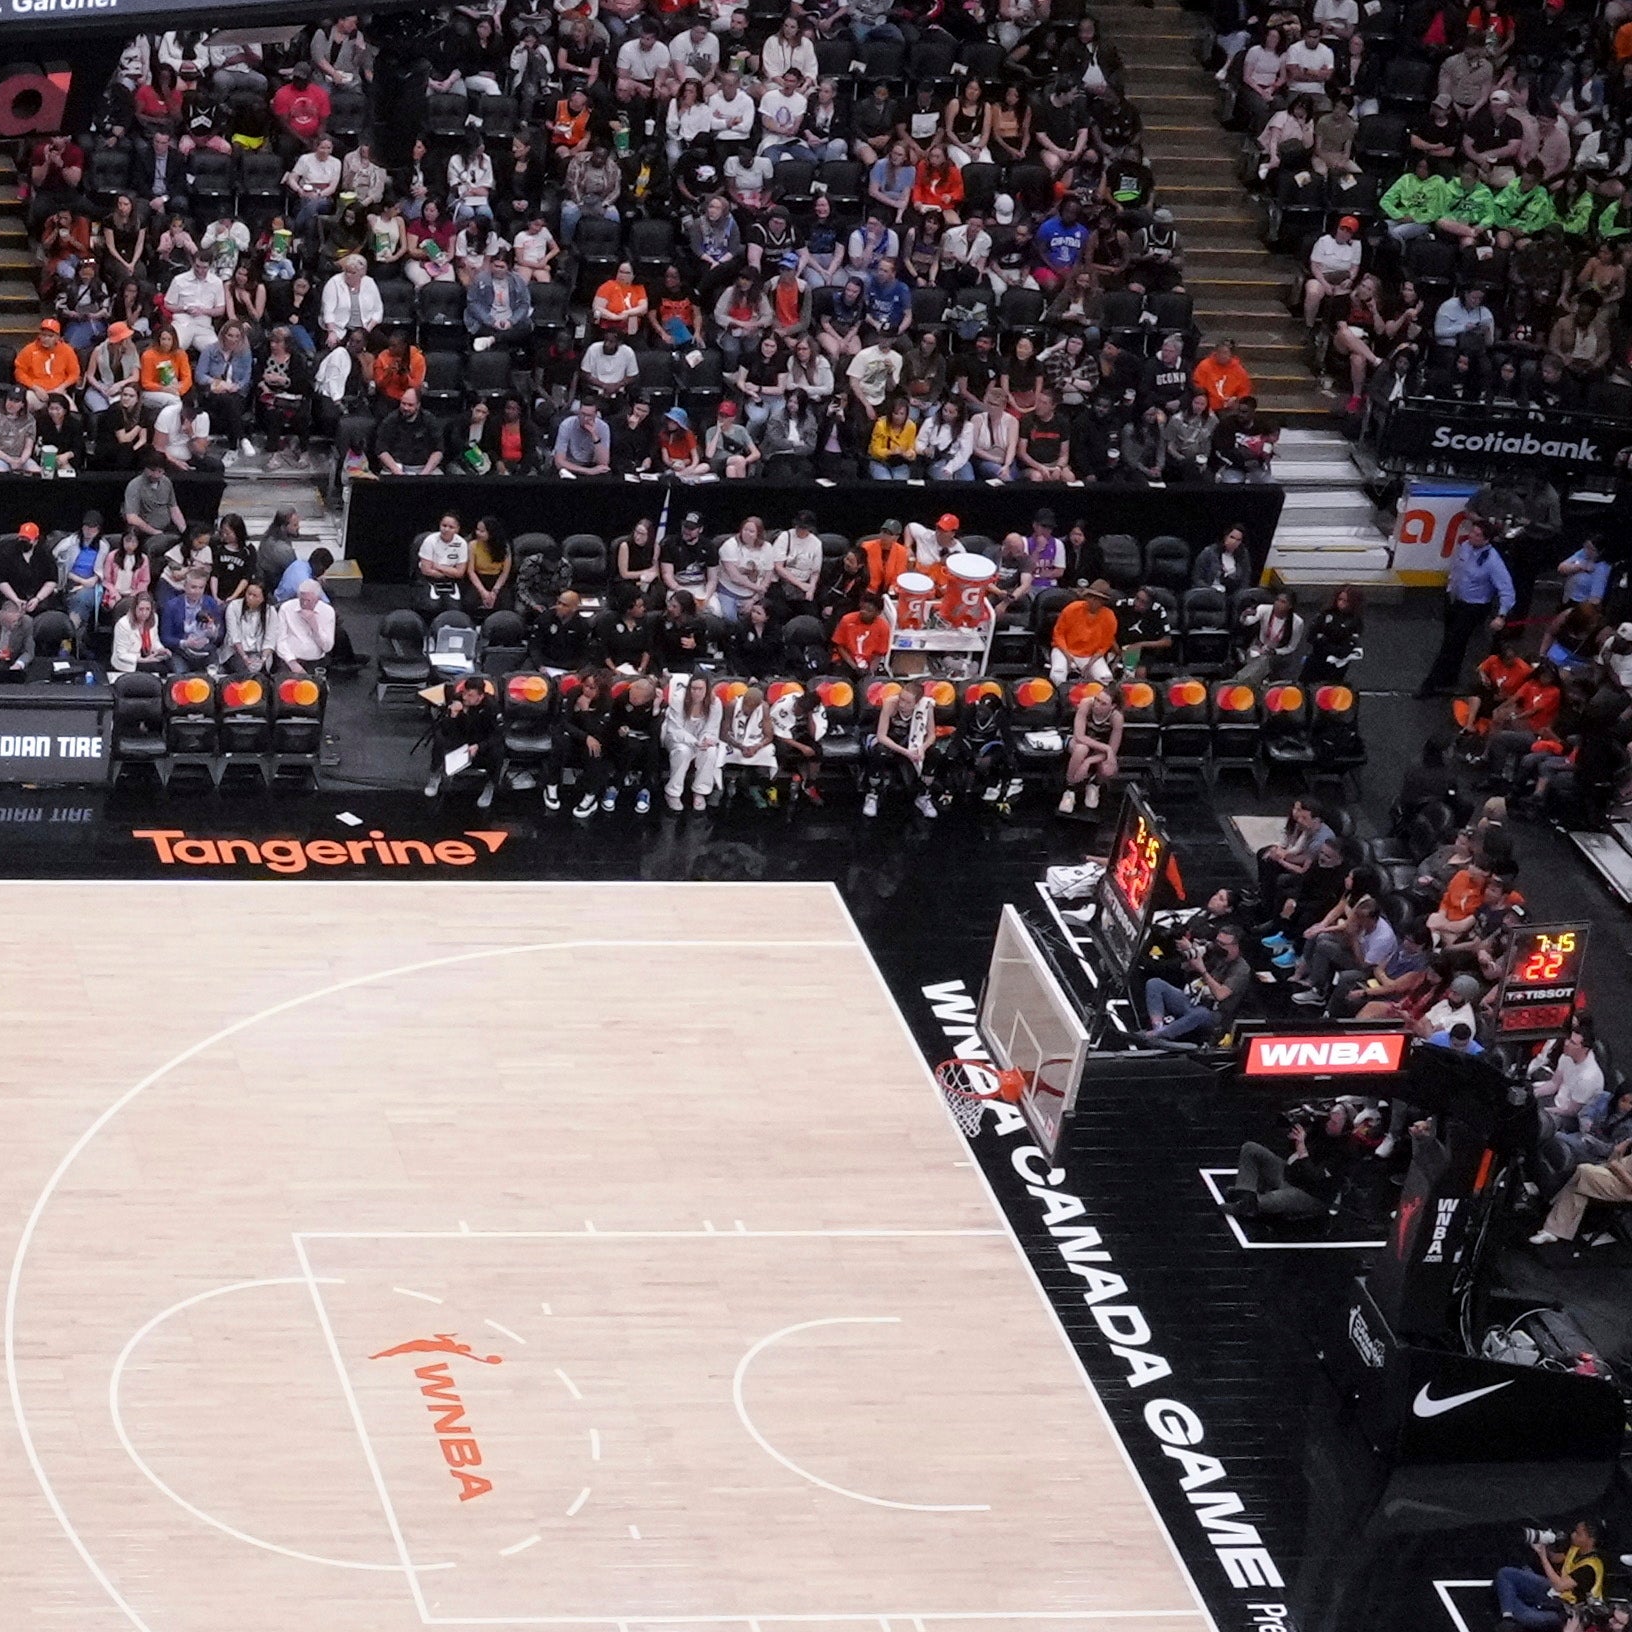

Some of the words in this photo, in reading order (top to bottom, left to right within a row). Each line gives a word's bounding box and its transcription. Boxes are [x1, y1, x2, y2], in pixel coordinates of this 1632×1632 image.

[56, 736, 103, 758] TIRE
[132, 828, 477, 873] Tangerine
[1537, 932, 1575, 953] 7:15
[1525, 953, 1563, 980] 22
[1524, 987, 1574, 1001] TISSOT
[1259, 1042, 1390, 1067] WNBA
[1011, 1145, 1171, 1389] CANADA
[1144, 1399, 1286, 1589] GAME
[413, 1362, 493, 1502] WNBA
